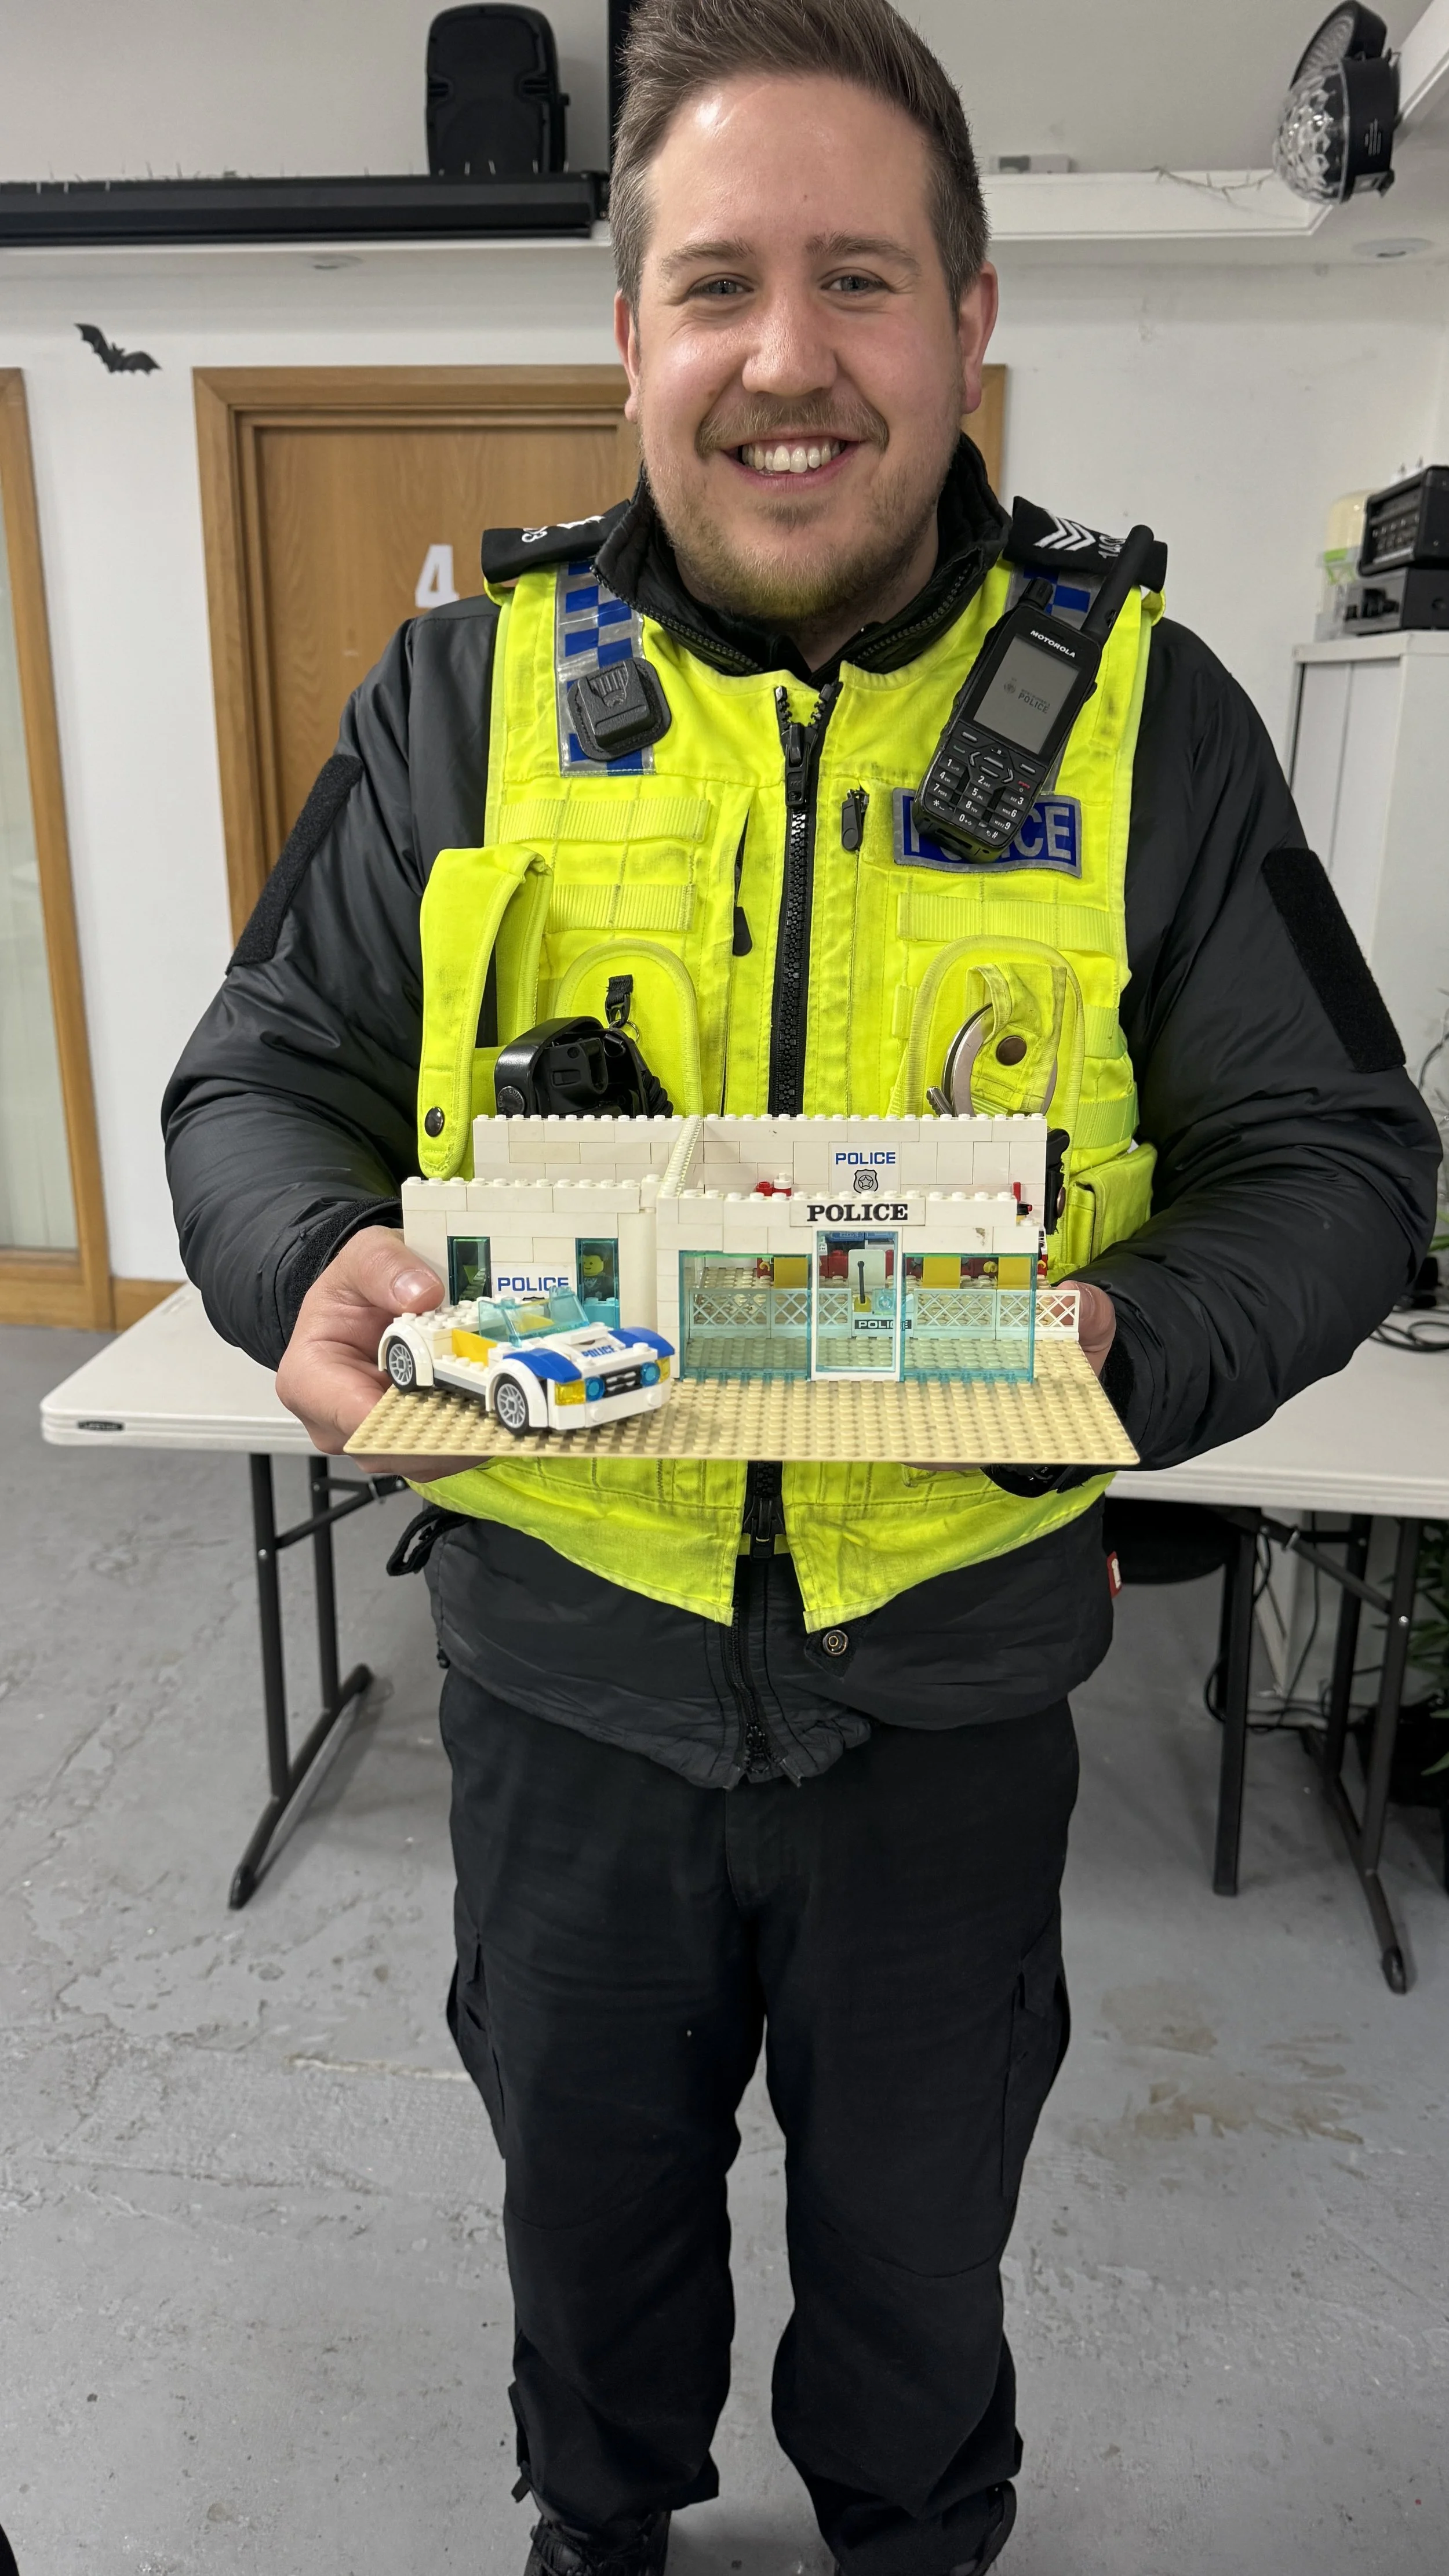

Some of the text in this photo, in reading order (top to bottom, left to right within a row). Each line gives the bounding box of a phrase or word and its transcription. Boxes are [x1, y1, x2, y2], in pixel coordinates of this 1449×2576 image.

[414, 544, 460, 608] 4
[1030, 630, 1075, 658] MOTOROLA
[1018, 692, 1049, 714] POLICE
[978, 776, 985, 784] 2
[972, 788, 978, 796] 5
[966, 801, 972, 809] 8
[959, 814, 965, 822] 0
[1011, 809, 1017, 817] 6
[1004, 822, 1011, 830] 9
[835, 1152, 895, 1165] POLICE
[807, 1203, 908, 1221] POLICE
[497, 1277, 569, 1291] POLICE
[581, 1345, 616, 1358] POLICE
